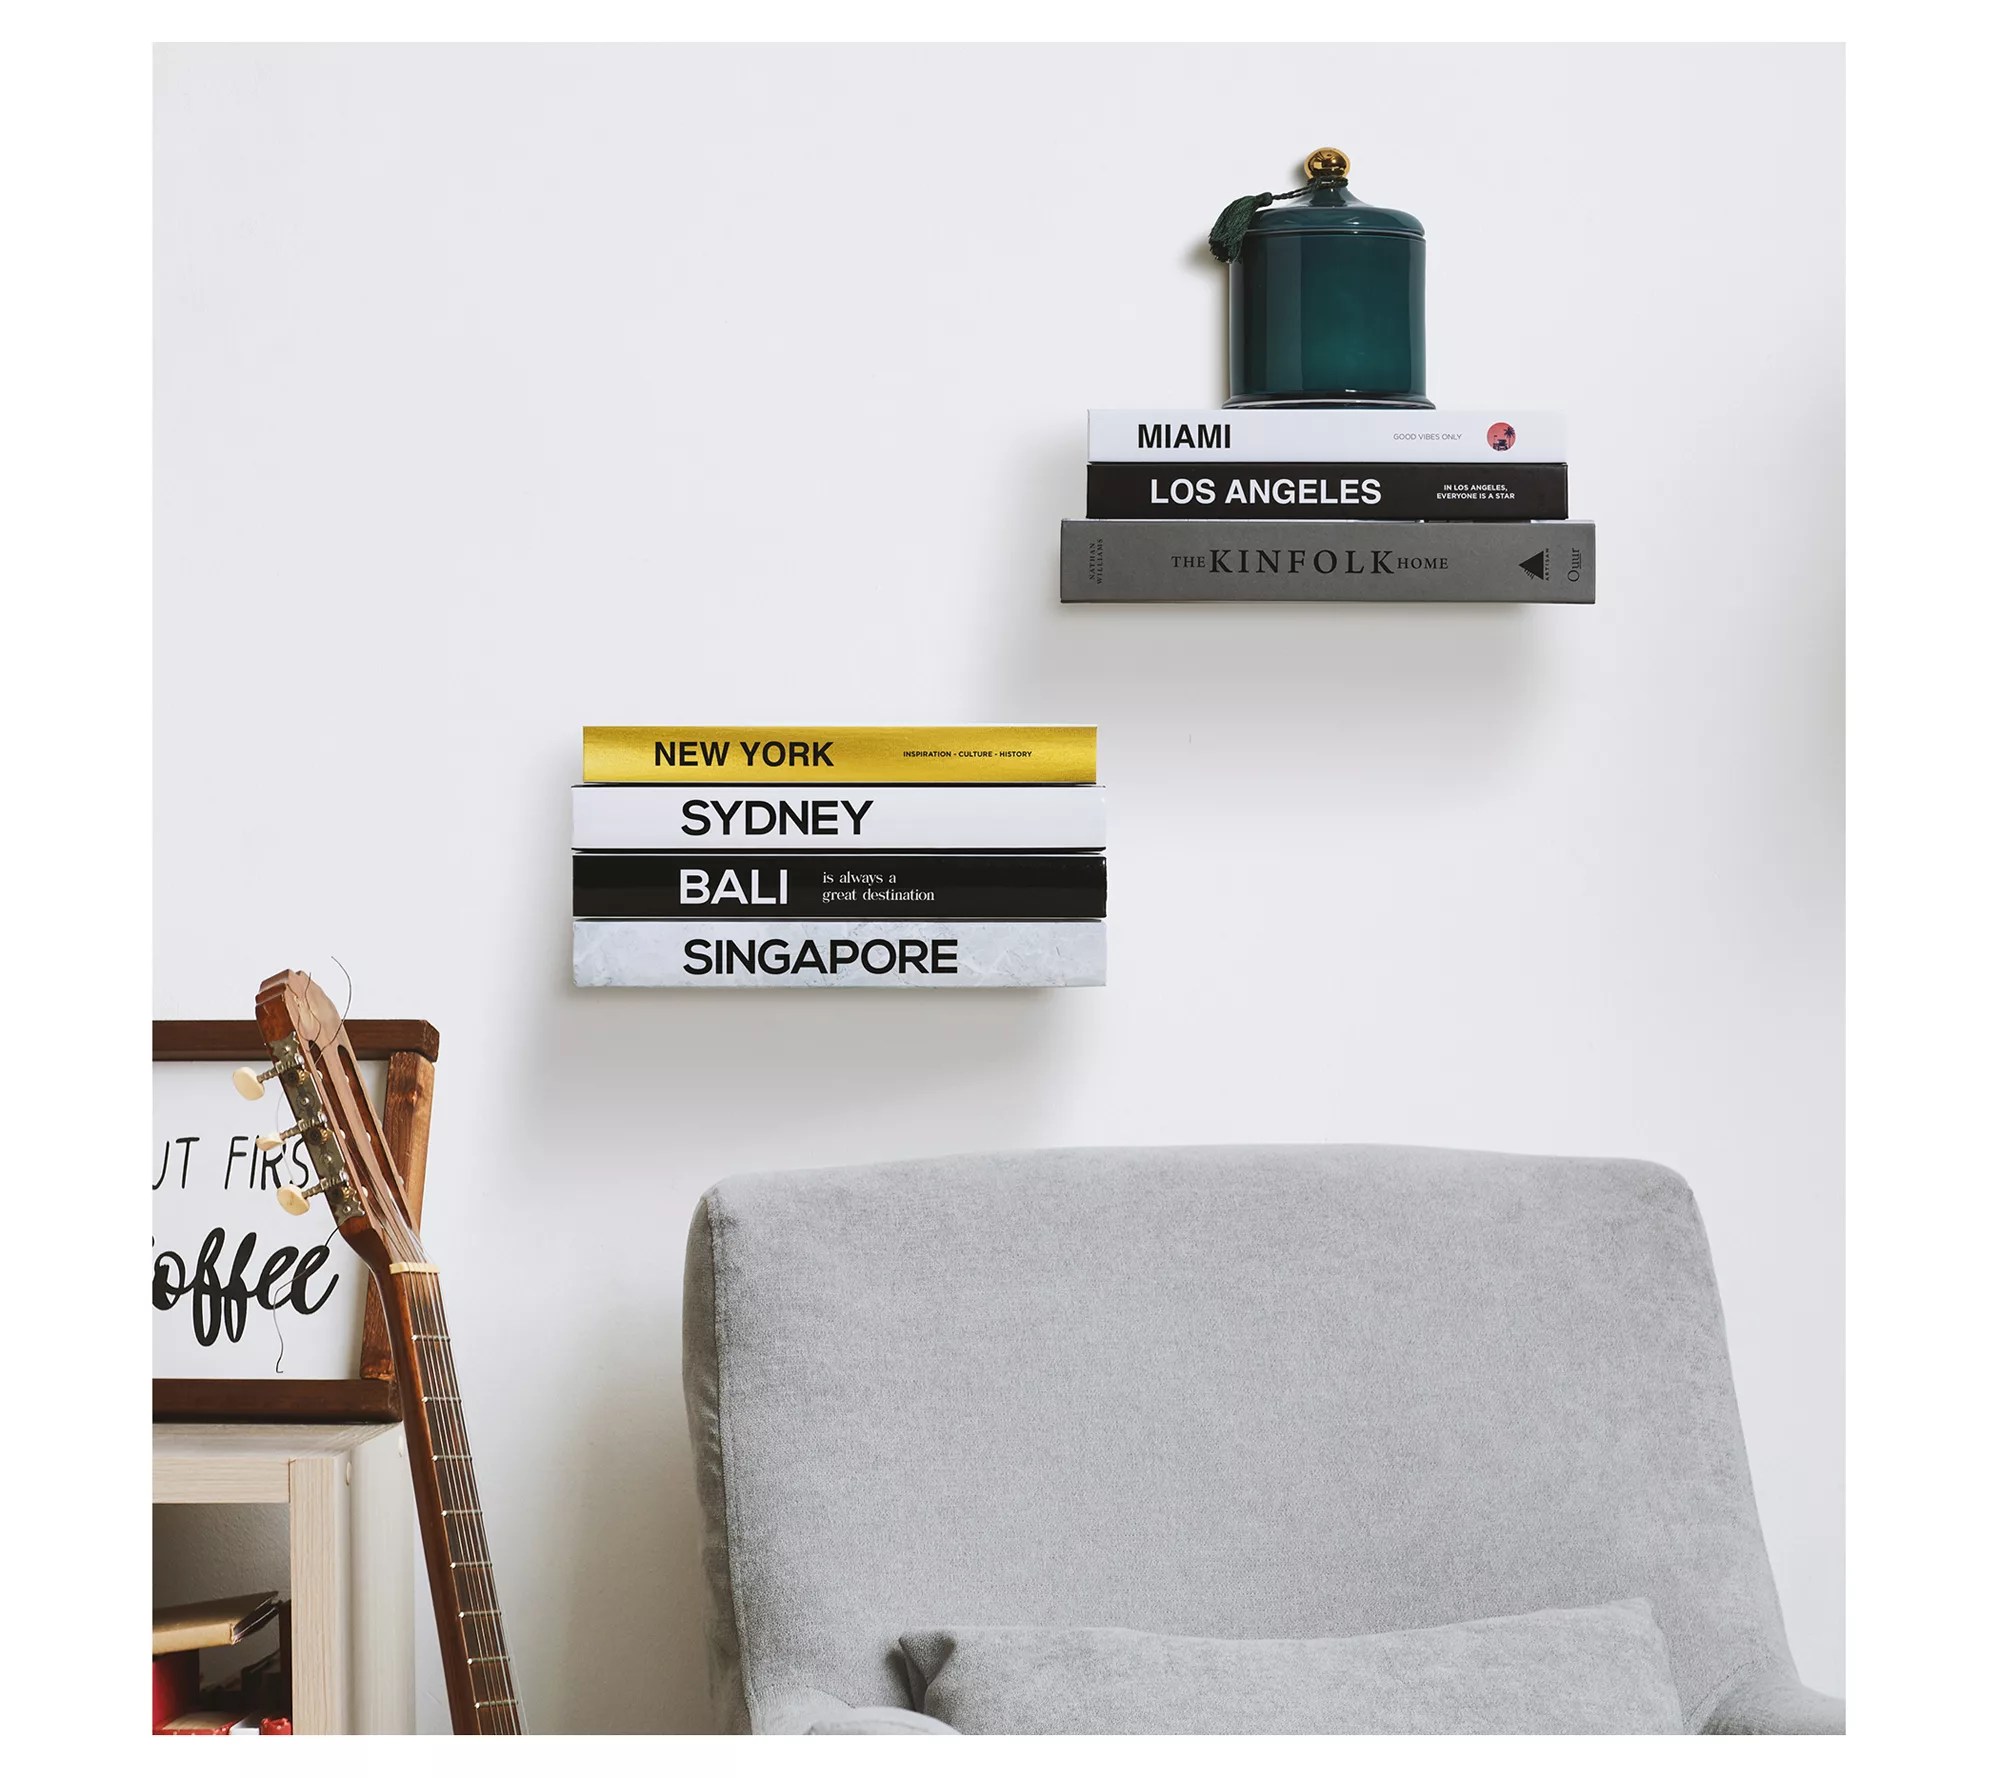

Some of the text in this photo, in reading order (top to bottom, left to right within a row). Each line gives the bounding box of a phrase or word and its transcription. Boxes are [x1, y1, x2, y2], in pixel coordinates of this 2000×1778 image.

[1138, 423, 1231, 449] MIAMI
[1393, 433, 1463, 441] GOOD VIBES ONLY
[1150, 478, 1382, 505] LOS ANGELES
[1436, 492, 1515, 500] EVERYONE IS A STAR
[1470, 484, 1508, 492] ANGELES,
[1088, 543, 1096, 580] NATHAN
[1170, 549, 1449, 575] THE KINFOLK HOME
[654, 740, 835, 768] NEW YORK
[902, 750, 952, 758] INSPIRATION
[957, 750, 993, 758] CULTURE
[999, 750, 1033, 758] HISTORY
[680, 799, 874, 837] SYDNEY
[679, 868, 788, 905] BALI
[822, 871, 897, 888] is always a
[822, 889, 935, 904] great destination
[682, 938, 958, 976] SINGAPORE
[152, 1135, 309, 1191] UT FIRS
[152, 1227, 340, 1347] offee
